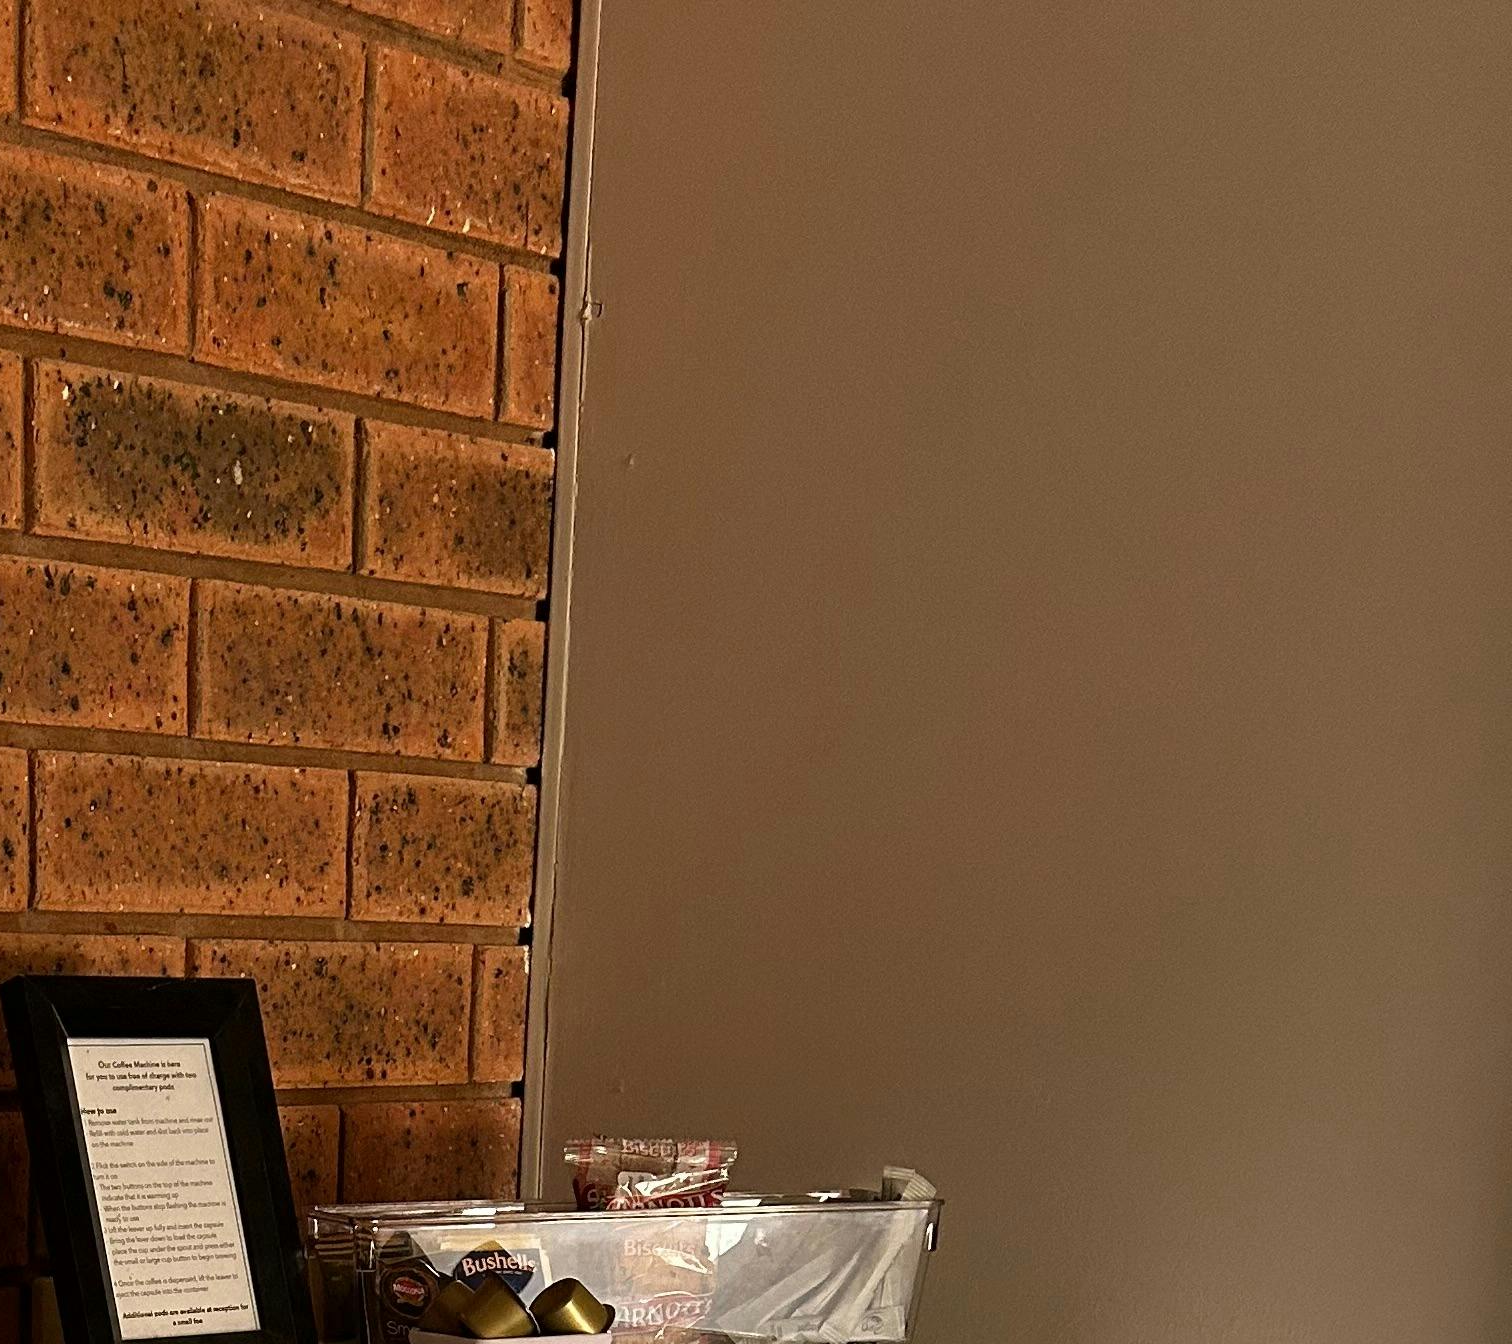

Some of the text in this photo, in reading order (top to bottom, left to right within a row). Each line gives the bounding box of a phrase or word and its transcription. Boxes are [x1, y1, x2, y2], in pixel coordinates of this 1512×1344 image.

[113, 1084, 158, 1092] complimentary
[461, 1251, 537, 1277] Bushells
[123, 1310, 154, 1319] Additional
